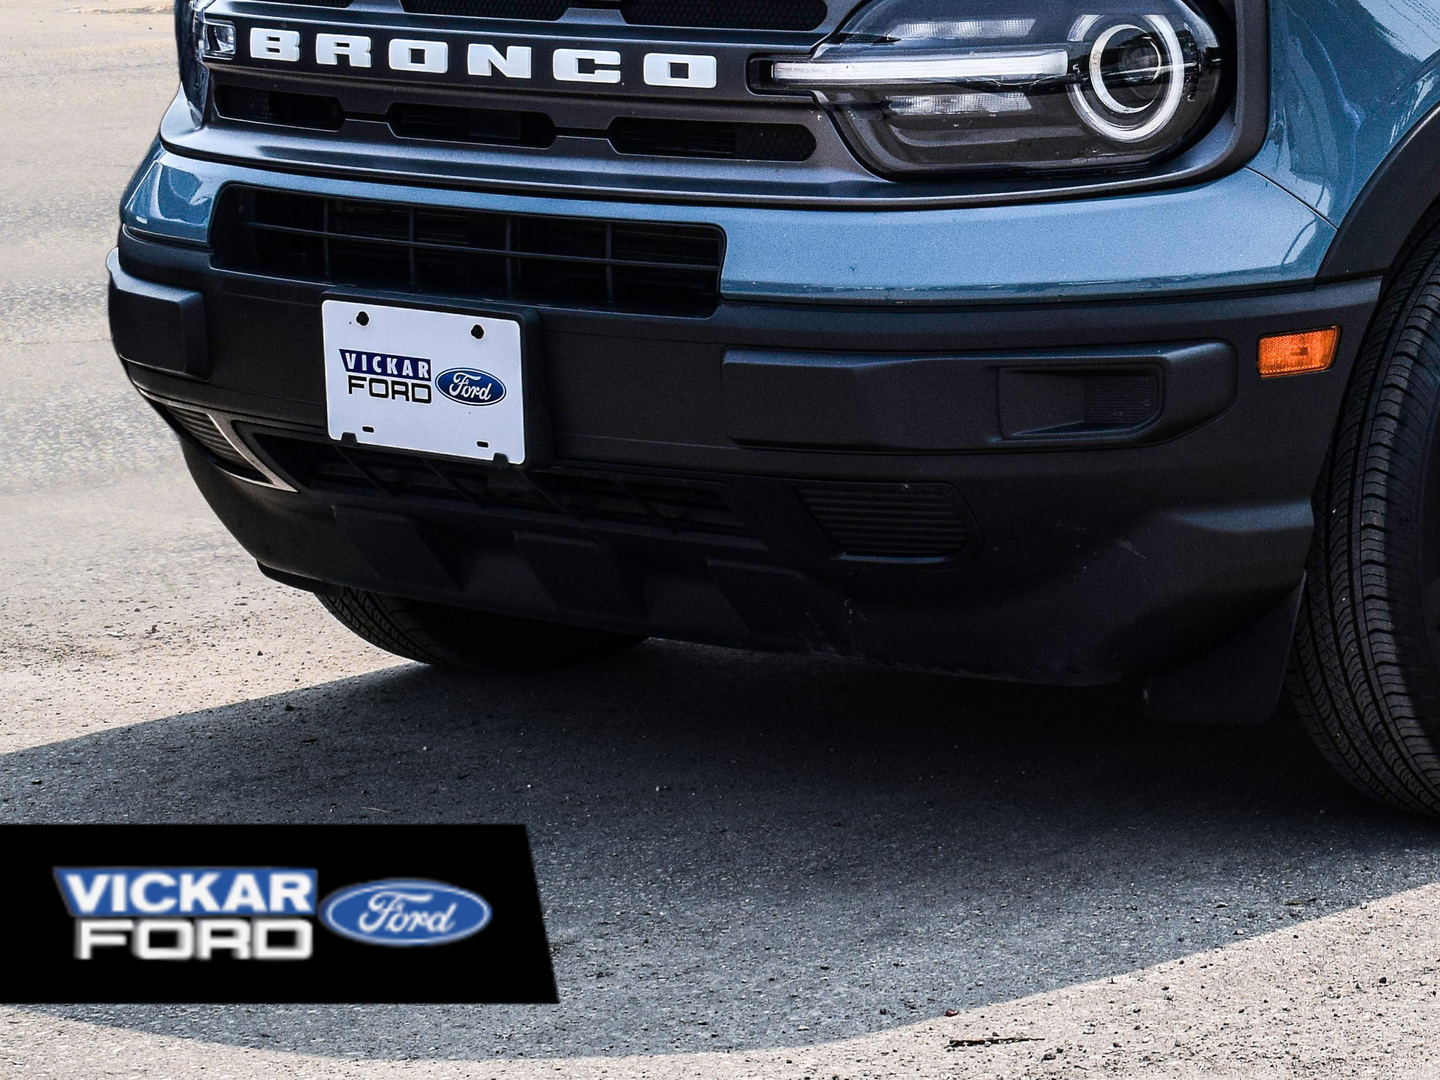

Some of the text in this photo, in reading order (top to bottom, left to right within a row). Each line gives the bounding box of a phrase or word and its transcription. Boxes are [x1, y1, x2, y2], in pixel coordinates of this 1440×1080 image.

[249, 27, 718, 88] BRONCO
[344, 352, 430, 379] VICKAR
[348, 372, 492, 404] FORD Ford
